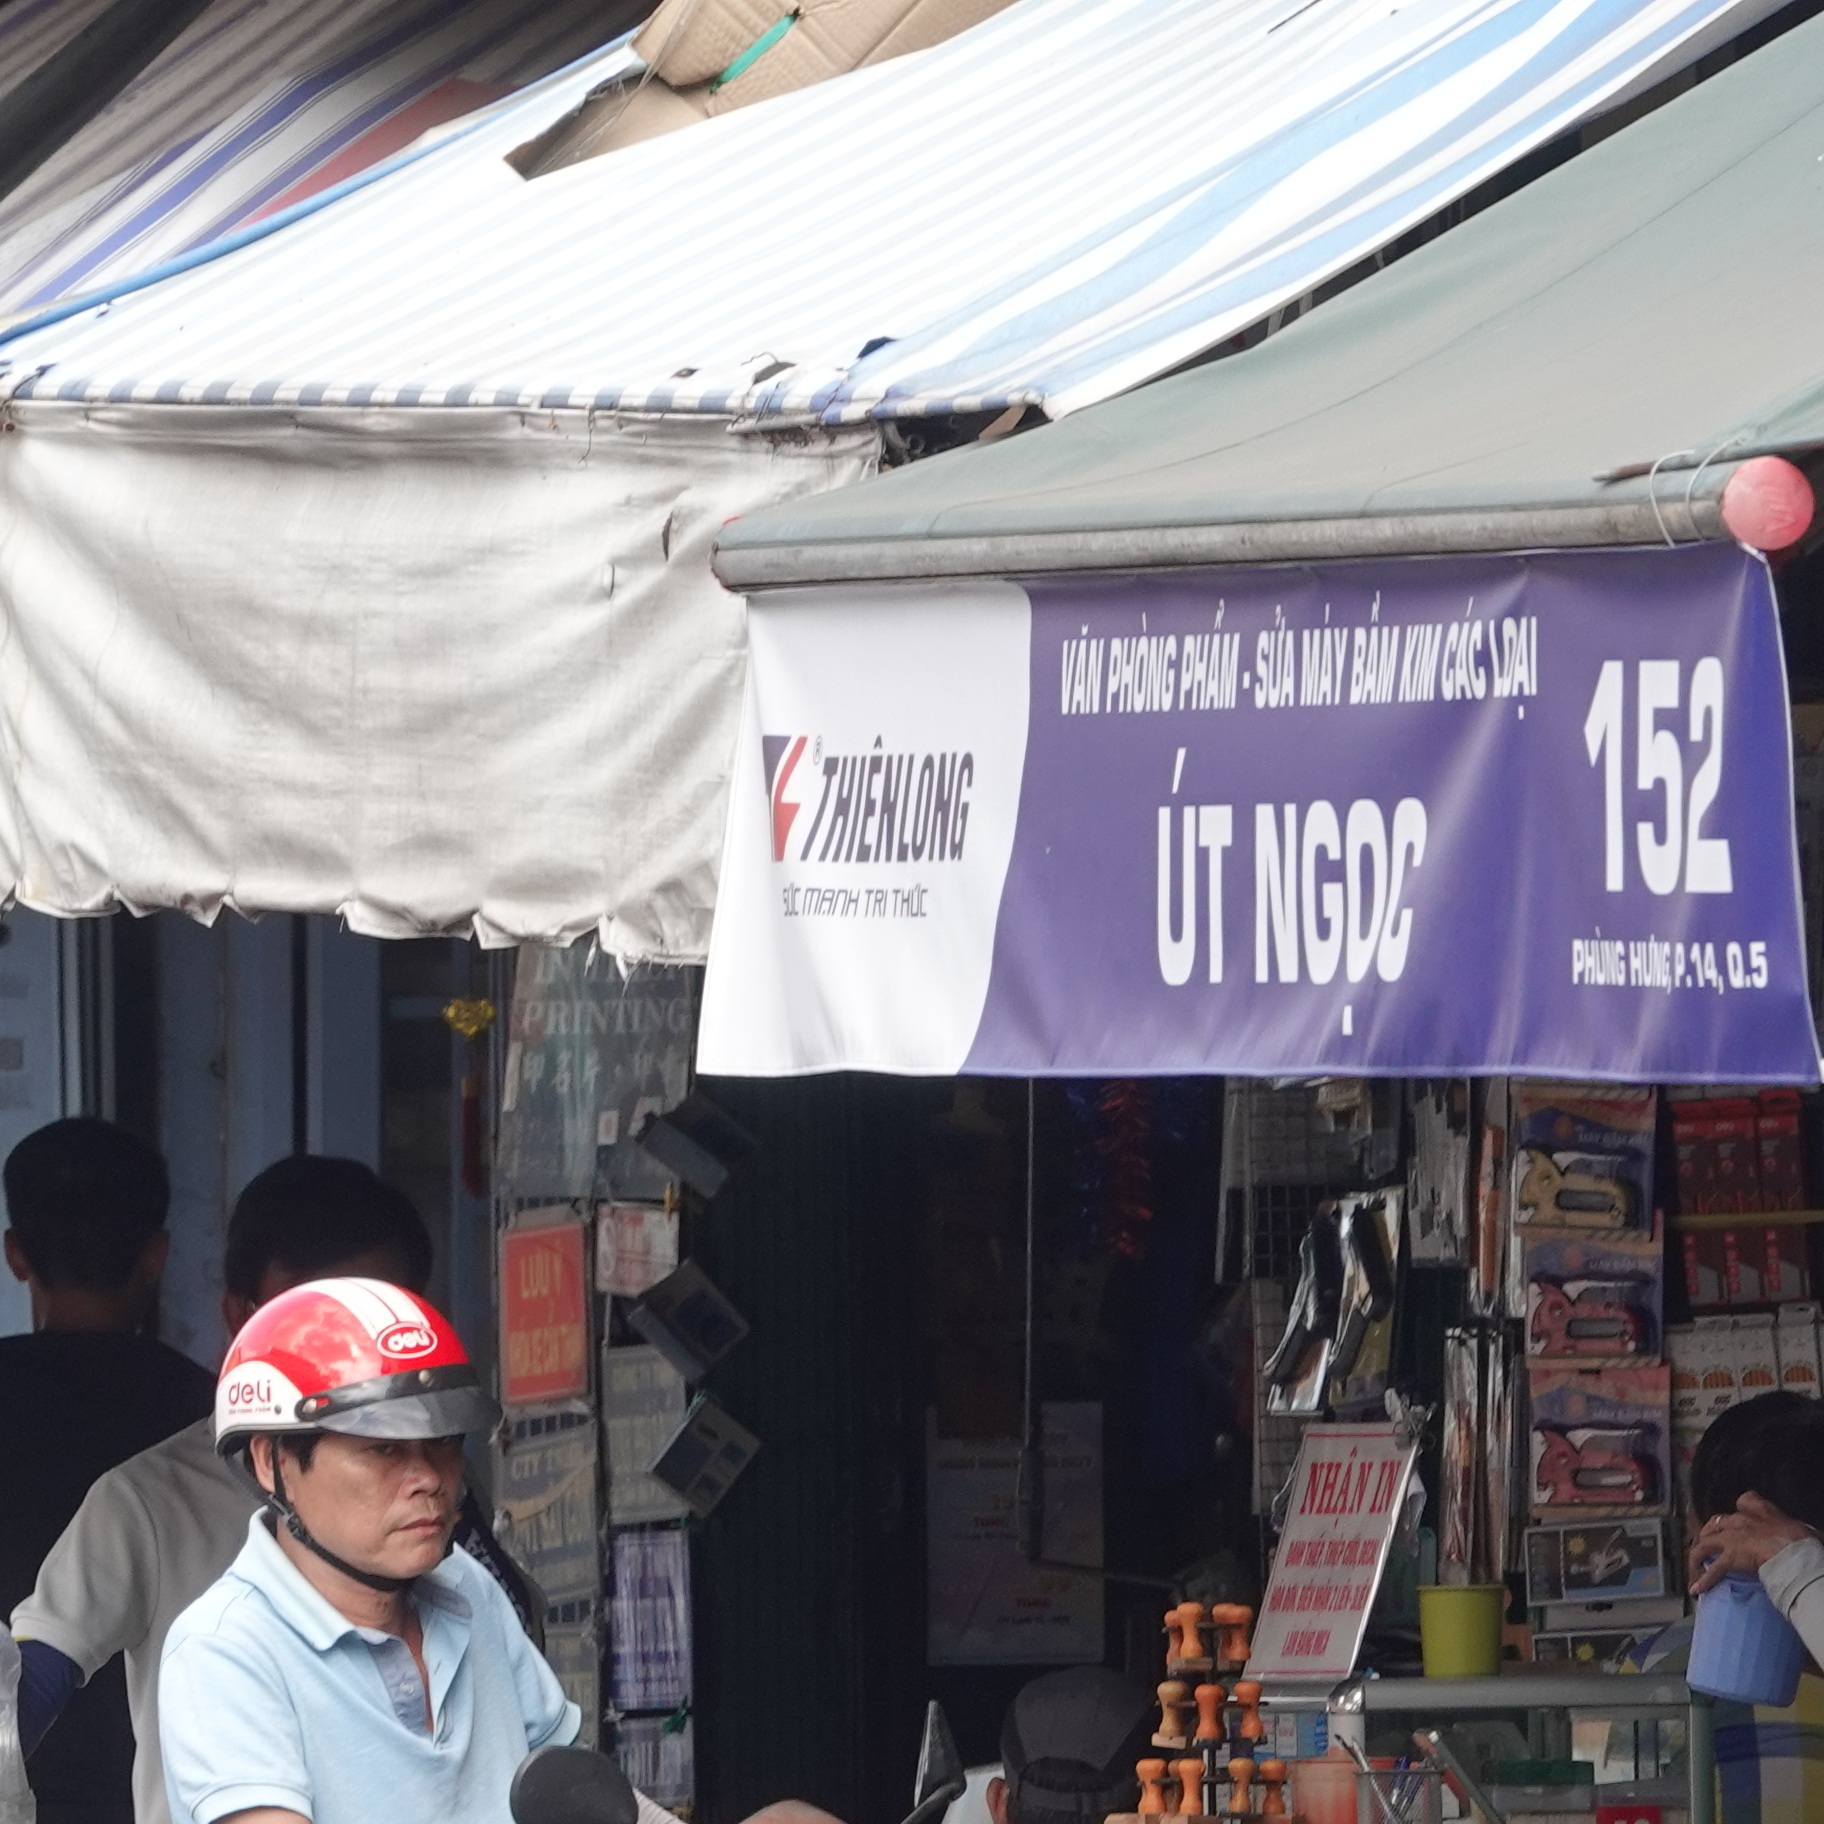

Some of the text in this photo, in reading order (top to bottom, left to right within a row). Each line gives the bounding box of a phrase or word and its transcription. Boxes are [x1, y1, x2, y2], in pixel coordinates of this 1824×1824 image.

[1062, 622, 1105, 714] VĂN
[1106, 612, 1177, 714] PHÒNG
[1179, 598, 1241, 710] PHẨM
[1242, 671, 1251, 689] -
[1255, 603, 1294, 709] SỬA
[1301, 602, 1348, 706] MÁY
[1350, 590, 1400, 705] BẤM
[1399, 622, 1443, 702] KIM
[1441, 596, 1486, 702] CÁC
[799, 734, 974, 863] THIÊNLONG
[1584, 655, 1735, 895] 152
[864, 887, 888, 918] TRI
[893, 882, 928, 918] THỨC
[1156, 746, 1428, 1037] ÚT NGỌC
[1572, 926, 1768, 996] PHÙNG HƯNG, P.14, Q.5
[228, 1379, 272, 1405] deli
[1299, 1446, 1402, 1529] NHẬN IN
